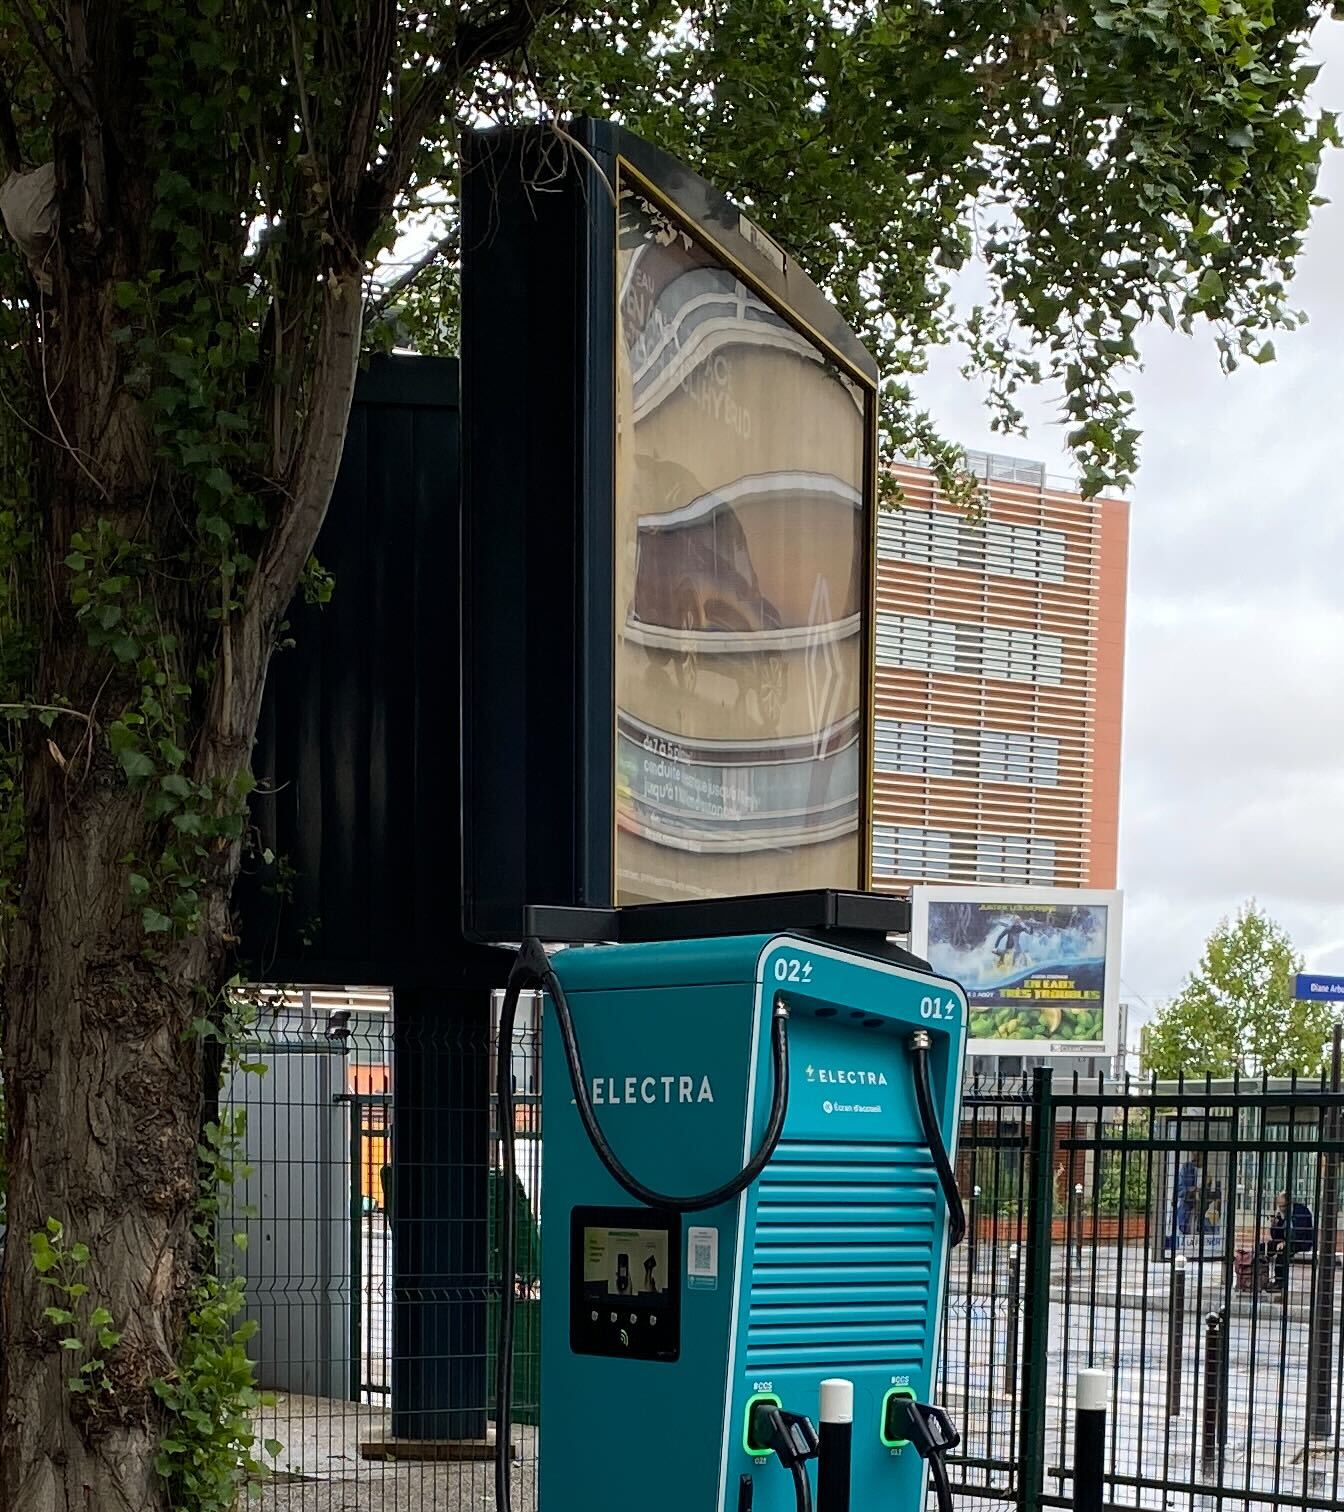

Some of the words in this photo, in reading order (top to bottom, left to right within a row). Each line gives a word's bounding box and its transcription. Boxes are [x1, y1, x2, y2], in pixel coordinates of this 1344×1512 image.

[775, 959, 799, 981] 02
[1310, 983, 1329, 993] Diane
[920, 998, 942, 1018] 01
[819, 1069, 888, 1086] ELECTRA
[592, 1075, 714, 1105] ELECTRA
